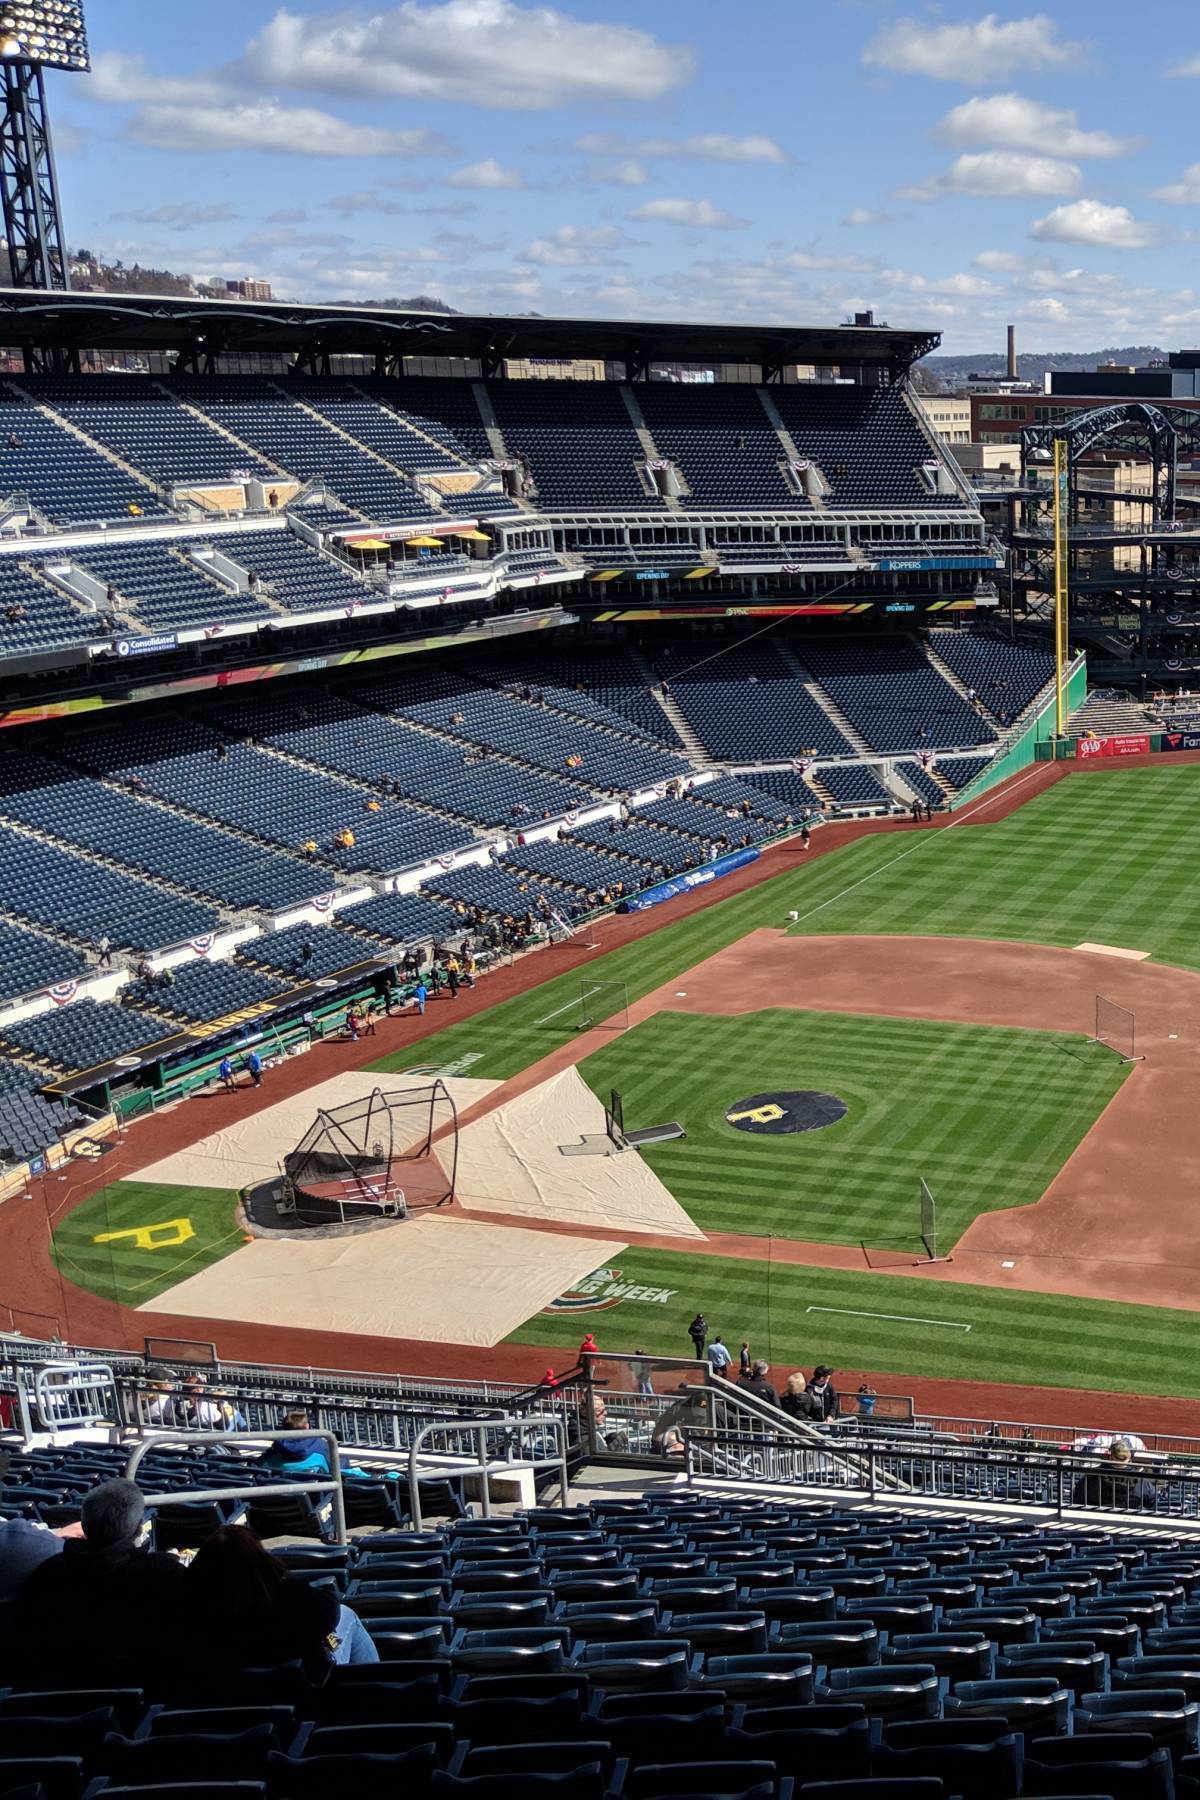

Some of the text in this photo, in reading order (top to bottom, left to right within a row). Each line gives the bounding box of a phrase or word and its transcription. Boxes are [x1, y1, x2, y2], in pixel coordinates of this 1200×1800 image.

[889, 561, 922, 570] KOPPERS
[130, 635, 175, 648] Consolidated
[1082, 741, 1100, 752] AAA
[602, 1282, 680, 1304] WEEK
